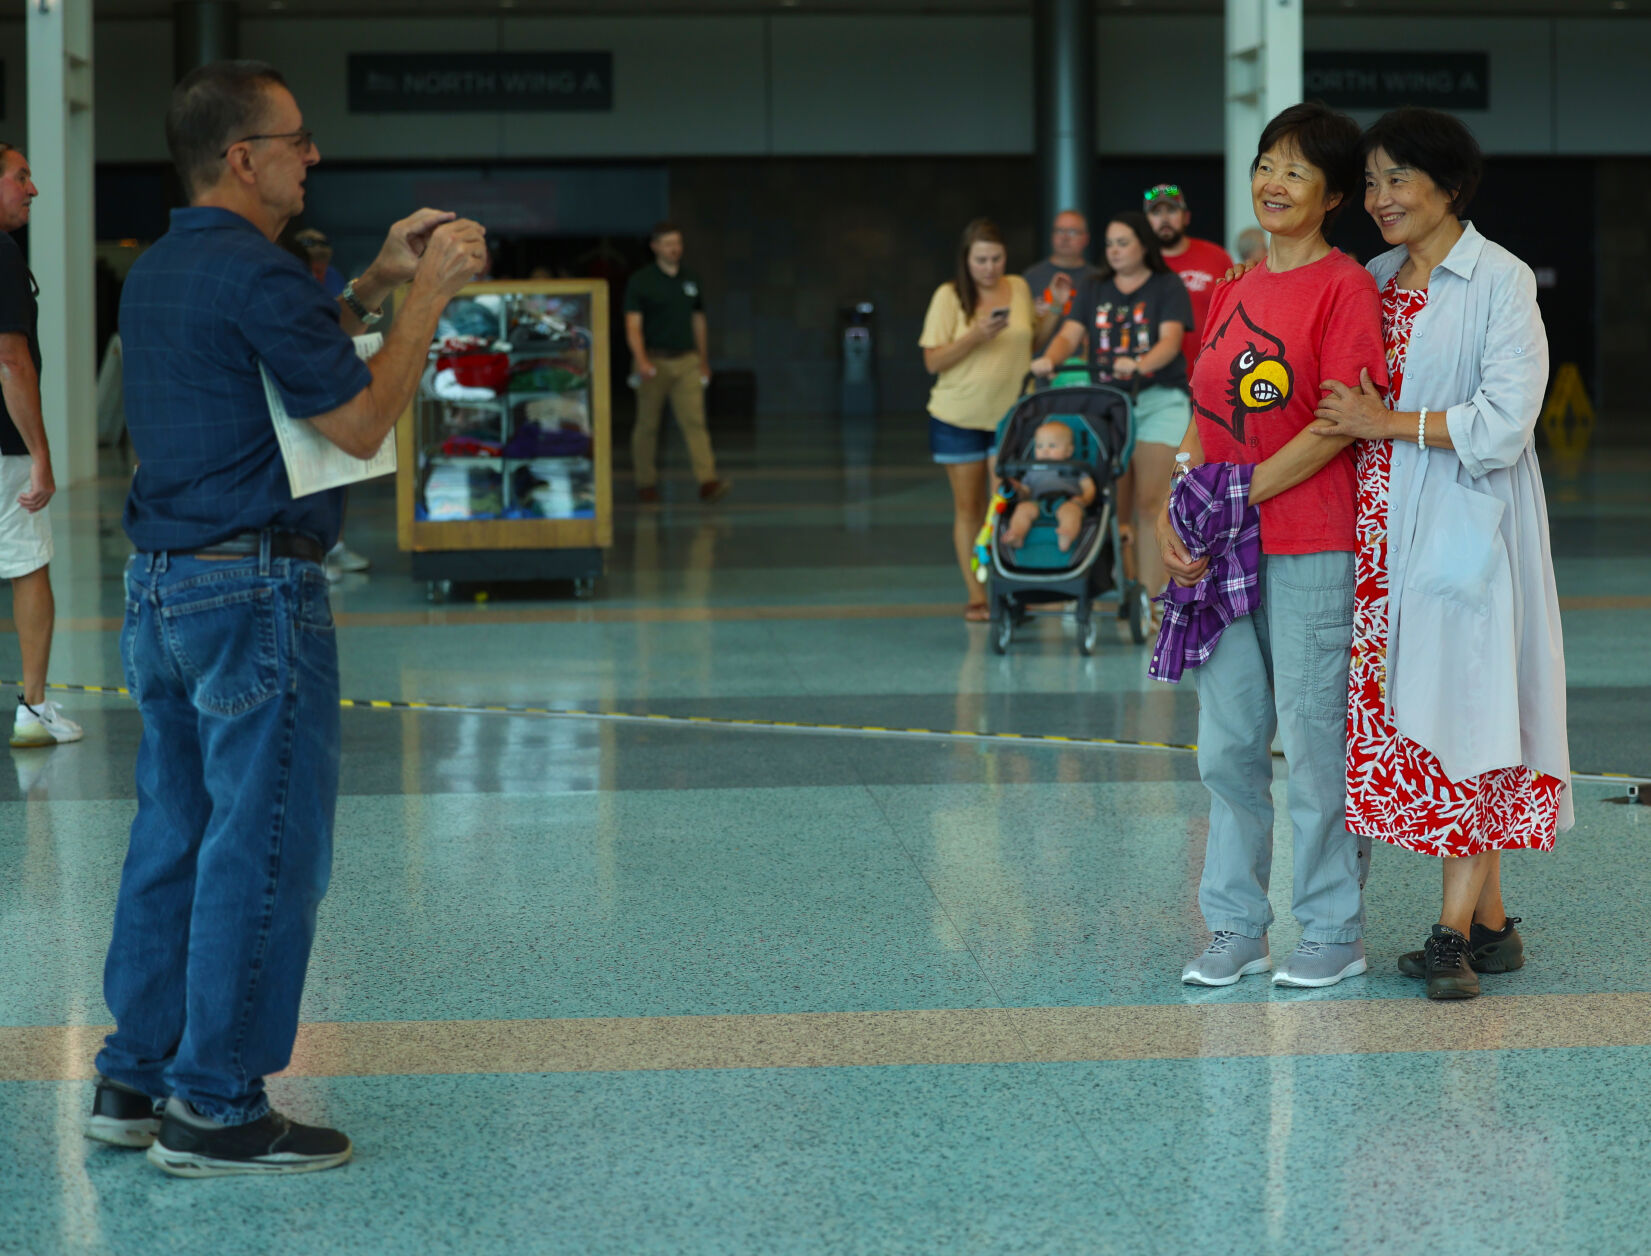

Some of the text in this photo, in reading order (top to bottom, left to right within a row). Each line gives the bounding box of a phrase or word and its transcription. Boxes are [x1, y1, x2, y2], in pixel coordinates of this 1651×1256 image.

[402, 72, 602, 94] NORTH WING A
[1305, 70, 1479, 93] ORTH WING A
